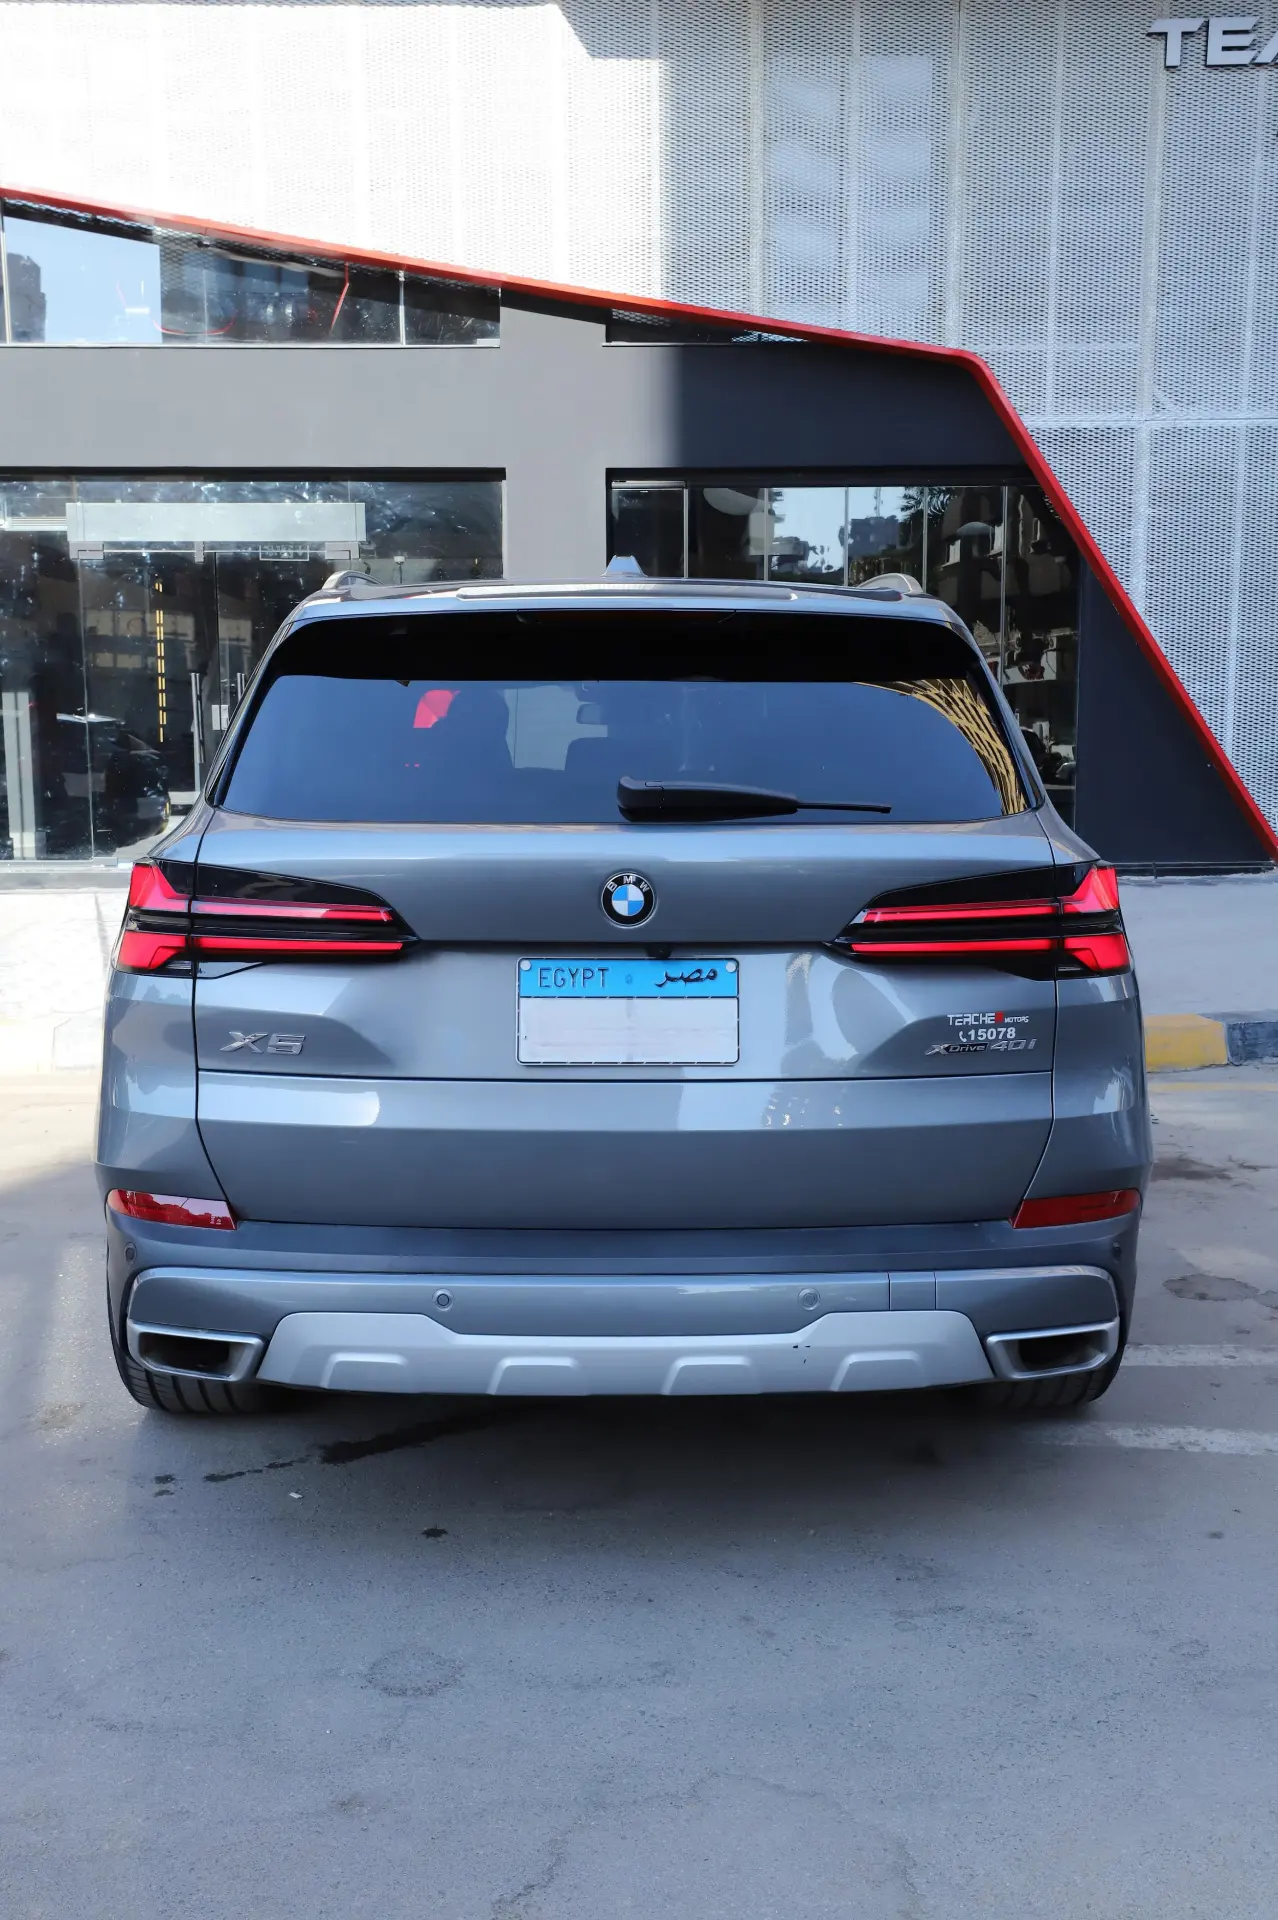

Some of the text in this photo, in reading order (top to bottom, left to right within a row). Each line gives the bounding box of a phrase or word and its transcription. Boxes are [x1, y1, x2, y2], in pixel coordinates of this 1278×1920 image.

[606, 875, 650, 892] BMW
[538, 967, 610, 988] EGYPT
[655, 967, 718, 988] مصر
[219, 1031, 306, 1055] X5
[968, 1027, 1016, 1041] 15078
